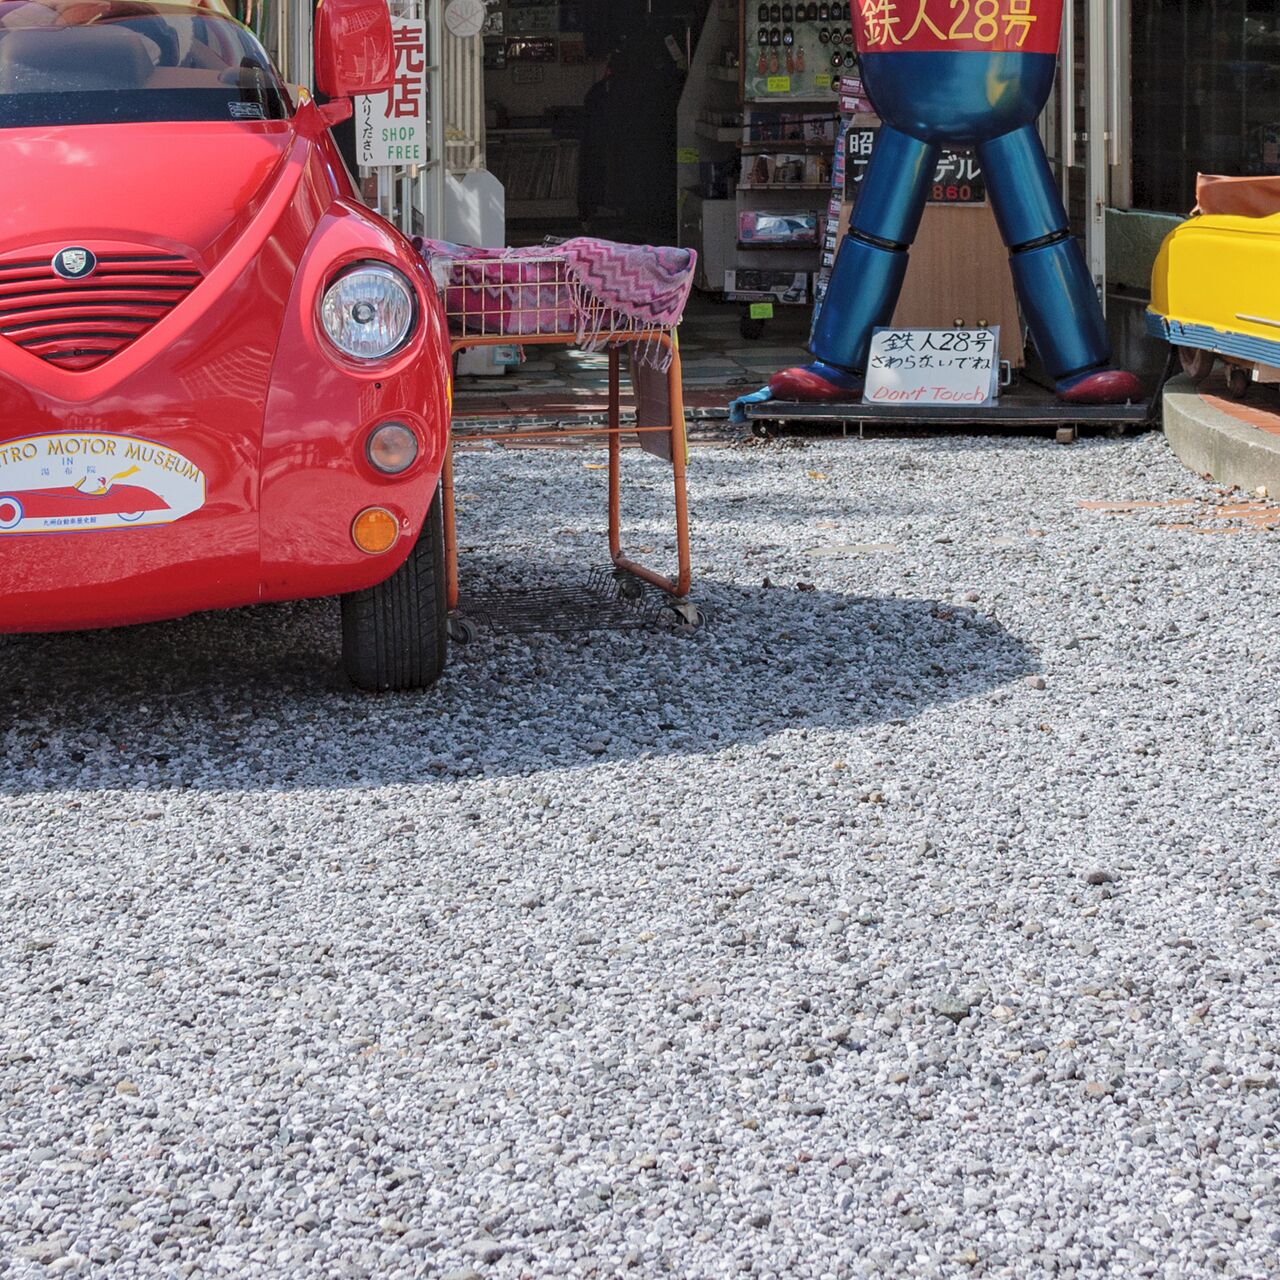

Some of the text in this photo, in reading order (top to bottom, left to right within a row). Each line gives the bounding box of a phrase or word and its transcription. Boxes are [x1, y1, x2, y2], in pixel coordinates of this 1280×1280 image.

[383, 25, 425, 119] 売店
[362, 95, 374, 162] 入りください
[382, 126, 415, 142] SHOP
[387, 144, 420, 160] FREE
[881, 332, 993, 353] 鉄人28号
[871, 355, 991, 370] さわらないでね
[930, 385, 985, 402] Touch
[47, 438, 117, 457] MOTOR
[124, 442, 201, 484] MUSEUM
[62, 456, 74, 467] IN
